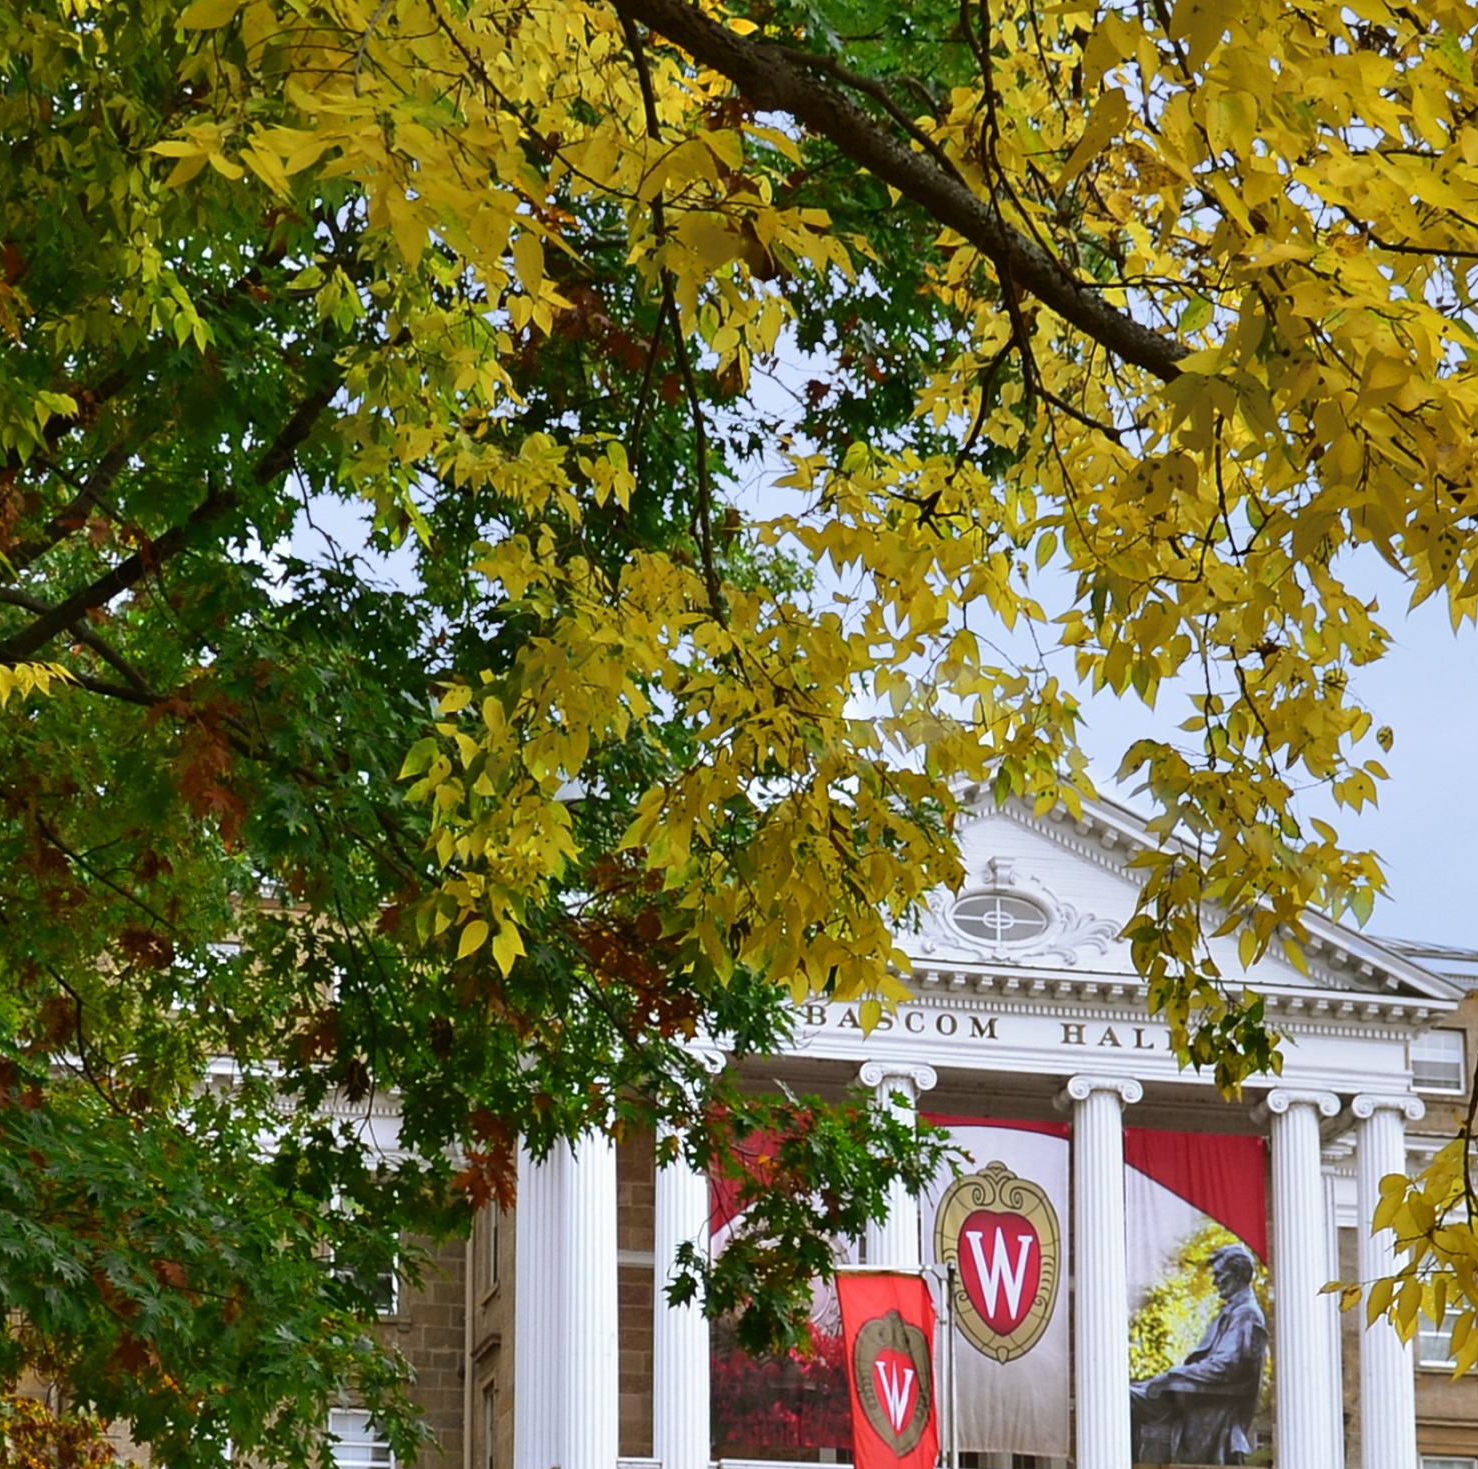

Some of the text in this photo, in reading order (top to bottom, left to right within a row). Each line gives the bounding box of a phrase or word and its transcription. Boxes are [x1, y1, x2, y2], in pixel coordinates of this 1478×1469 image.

[804, 1004, 1173, 1051] BASCOM HAL
[965, 1226, 1034, 1320] W
[875, 1361, 915, 1432] W
